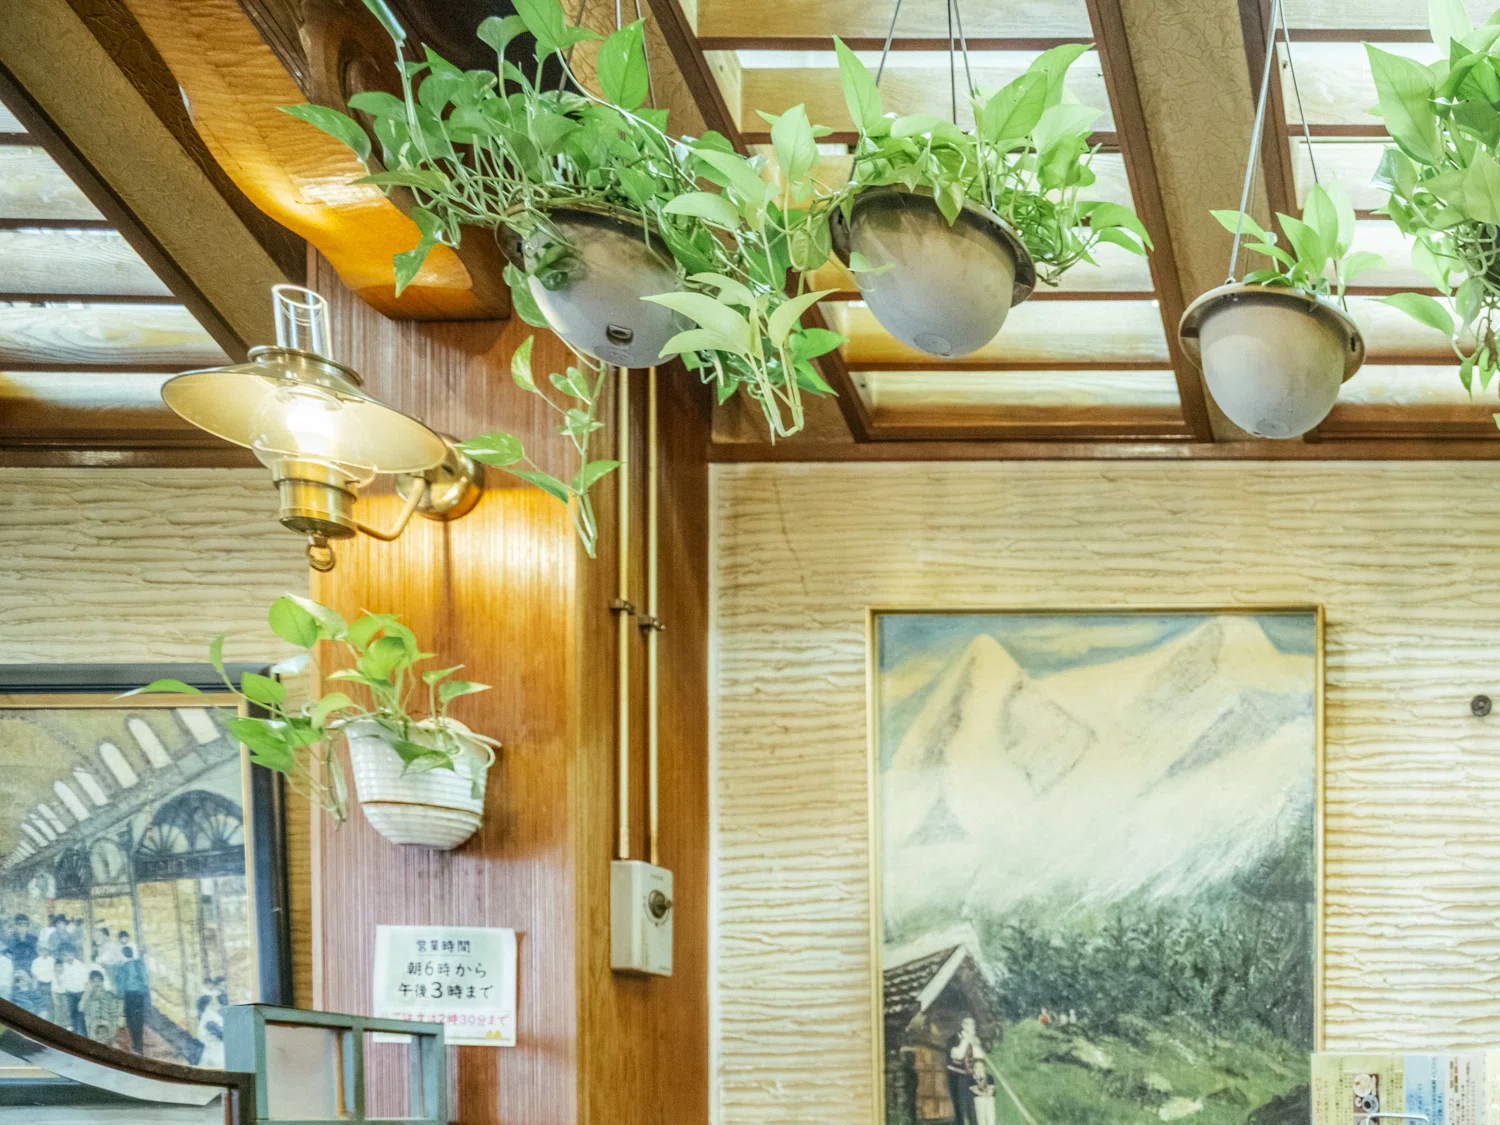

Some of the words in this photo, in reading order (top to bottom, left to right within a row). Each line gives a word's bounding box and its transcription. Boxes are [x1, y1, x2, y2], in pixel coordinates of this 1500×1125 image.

[416, 939, 471, 954] 営業時間
[407, 961, 487, 978] 朝6時から
[398, 981, 494, 999] 午後3時まで
